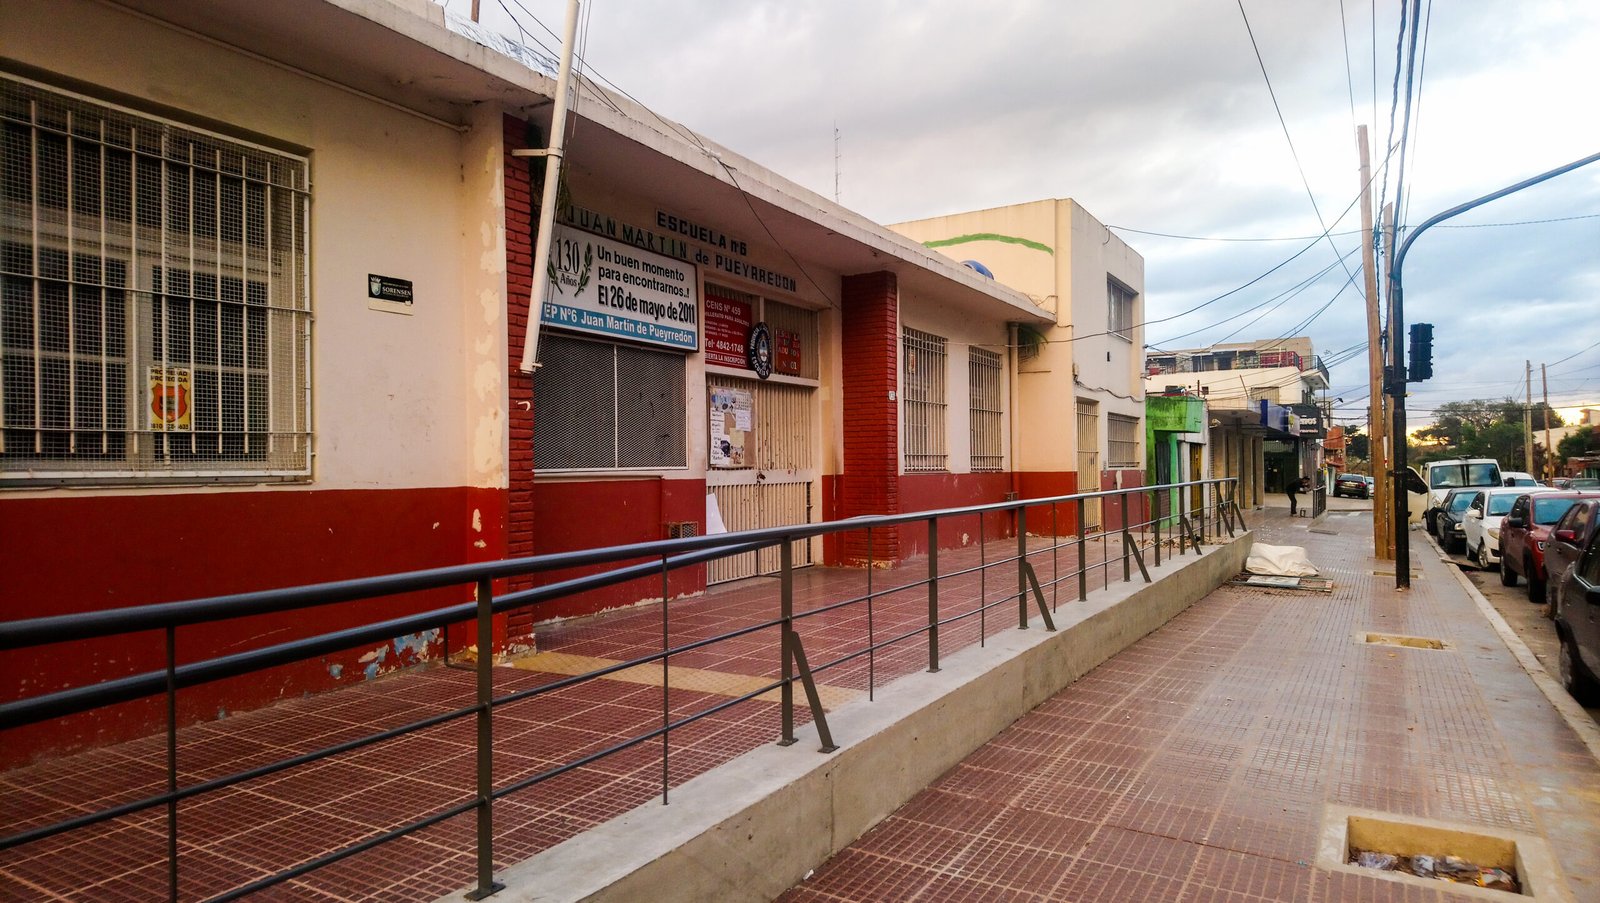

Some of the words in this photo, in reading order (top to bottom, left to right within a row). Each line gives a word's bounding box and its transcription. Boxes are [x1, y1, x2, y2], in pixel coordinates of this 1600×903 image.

[567, 205, 616, 237] JUAN
[622, 223, 688, 259] MARTIN
[695, 249, 710, 265] de
[657, 210, 727, 249] ESCUELA
[556, 237, 580, 274] 130
[597, 245, 612, 261] Un
[614, 251, 640, 270] buen
[642, 262, 685, 282] momento
[598, 266, 621, 281] para
[382, 286, 411, 296] SORENSEN
[560, 272, 578, 287] Años
[597, 284, 608, 306] El
[610, 285, 624, 309] 26
[626, 292, 638, 312] de
[639, 299, 665, 321] mayo
[666, 302, 677, 320] de
[678, 301, 695, 325] 2011
[705, 299, 723, 312] CENS
[544, 304, 558, 319] EP
[580, 311, 604, 328] Juan
[636, 321, 648, 335] de
[649, 323, 693, 344] Pueyrredón
